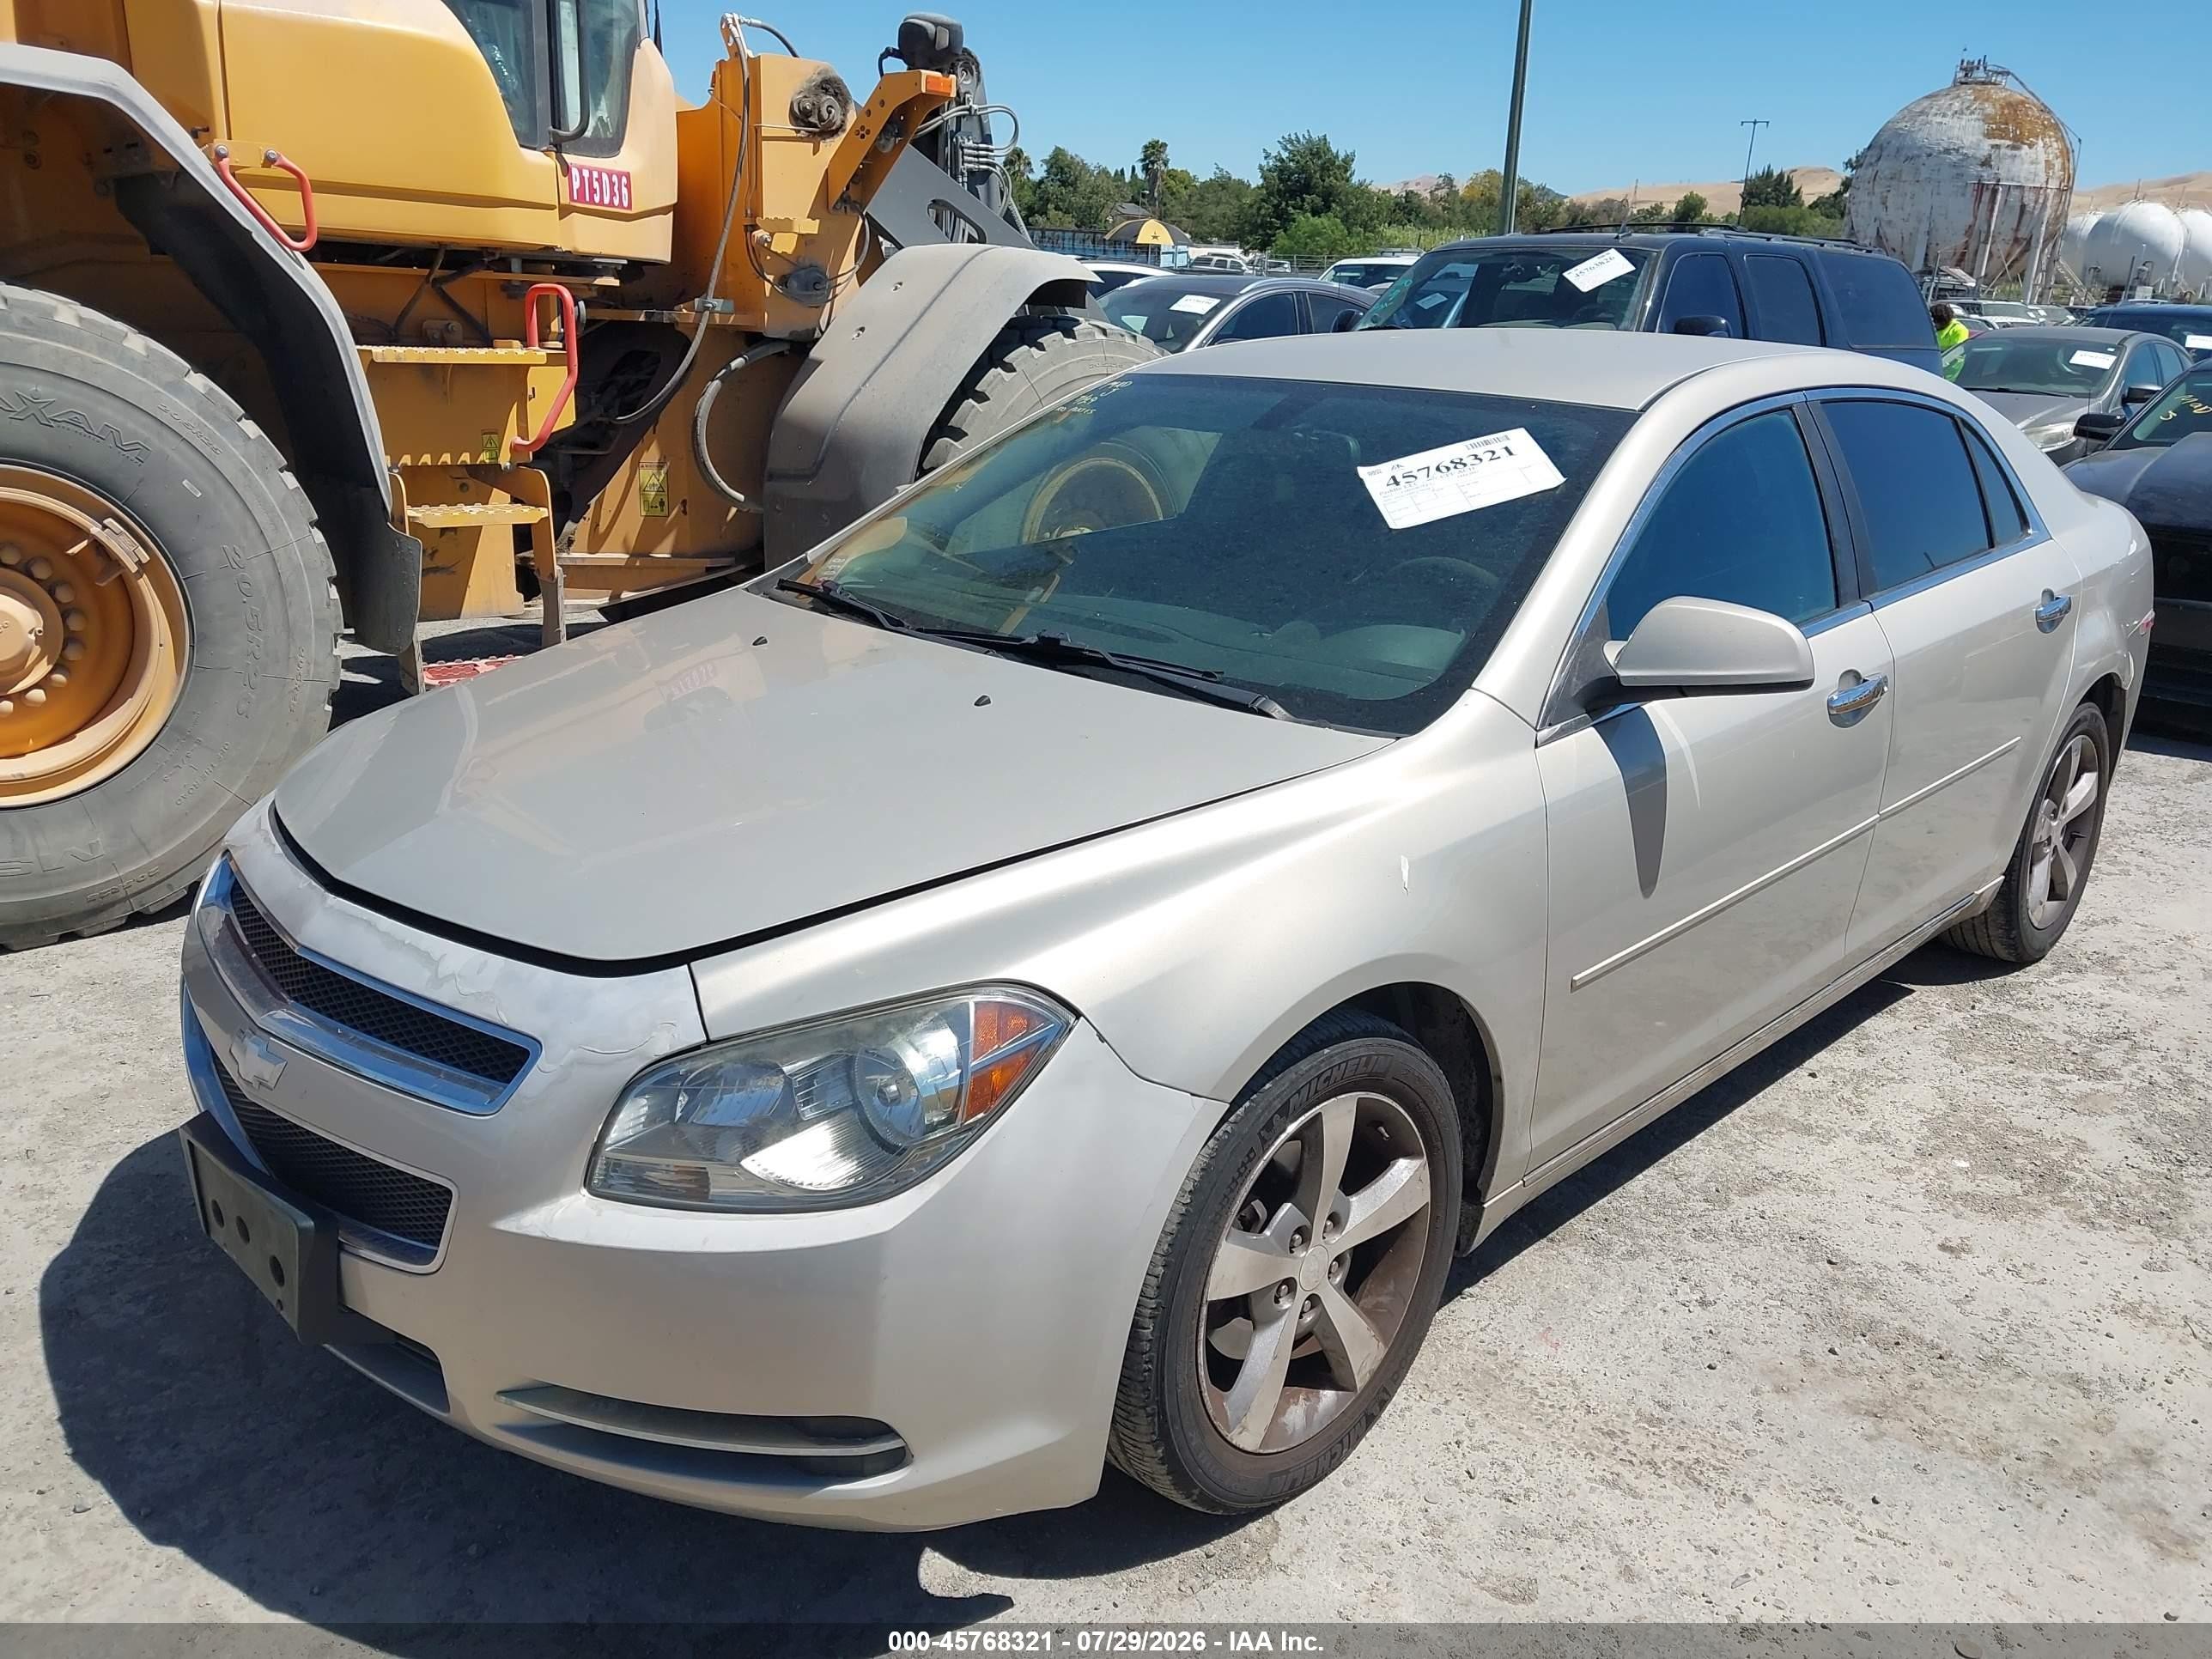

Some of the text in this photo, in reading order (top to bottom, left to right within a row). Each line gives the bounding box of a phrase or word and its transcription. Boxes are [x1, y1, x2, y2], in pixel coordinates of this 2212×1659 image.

[571, 167, 629, 208] PT5D36
[1386, 445, 1518, 487] 45768321
[1289, 1053, 1393, 1112] MICHELIN
